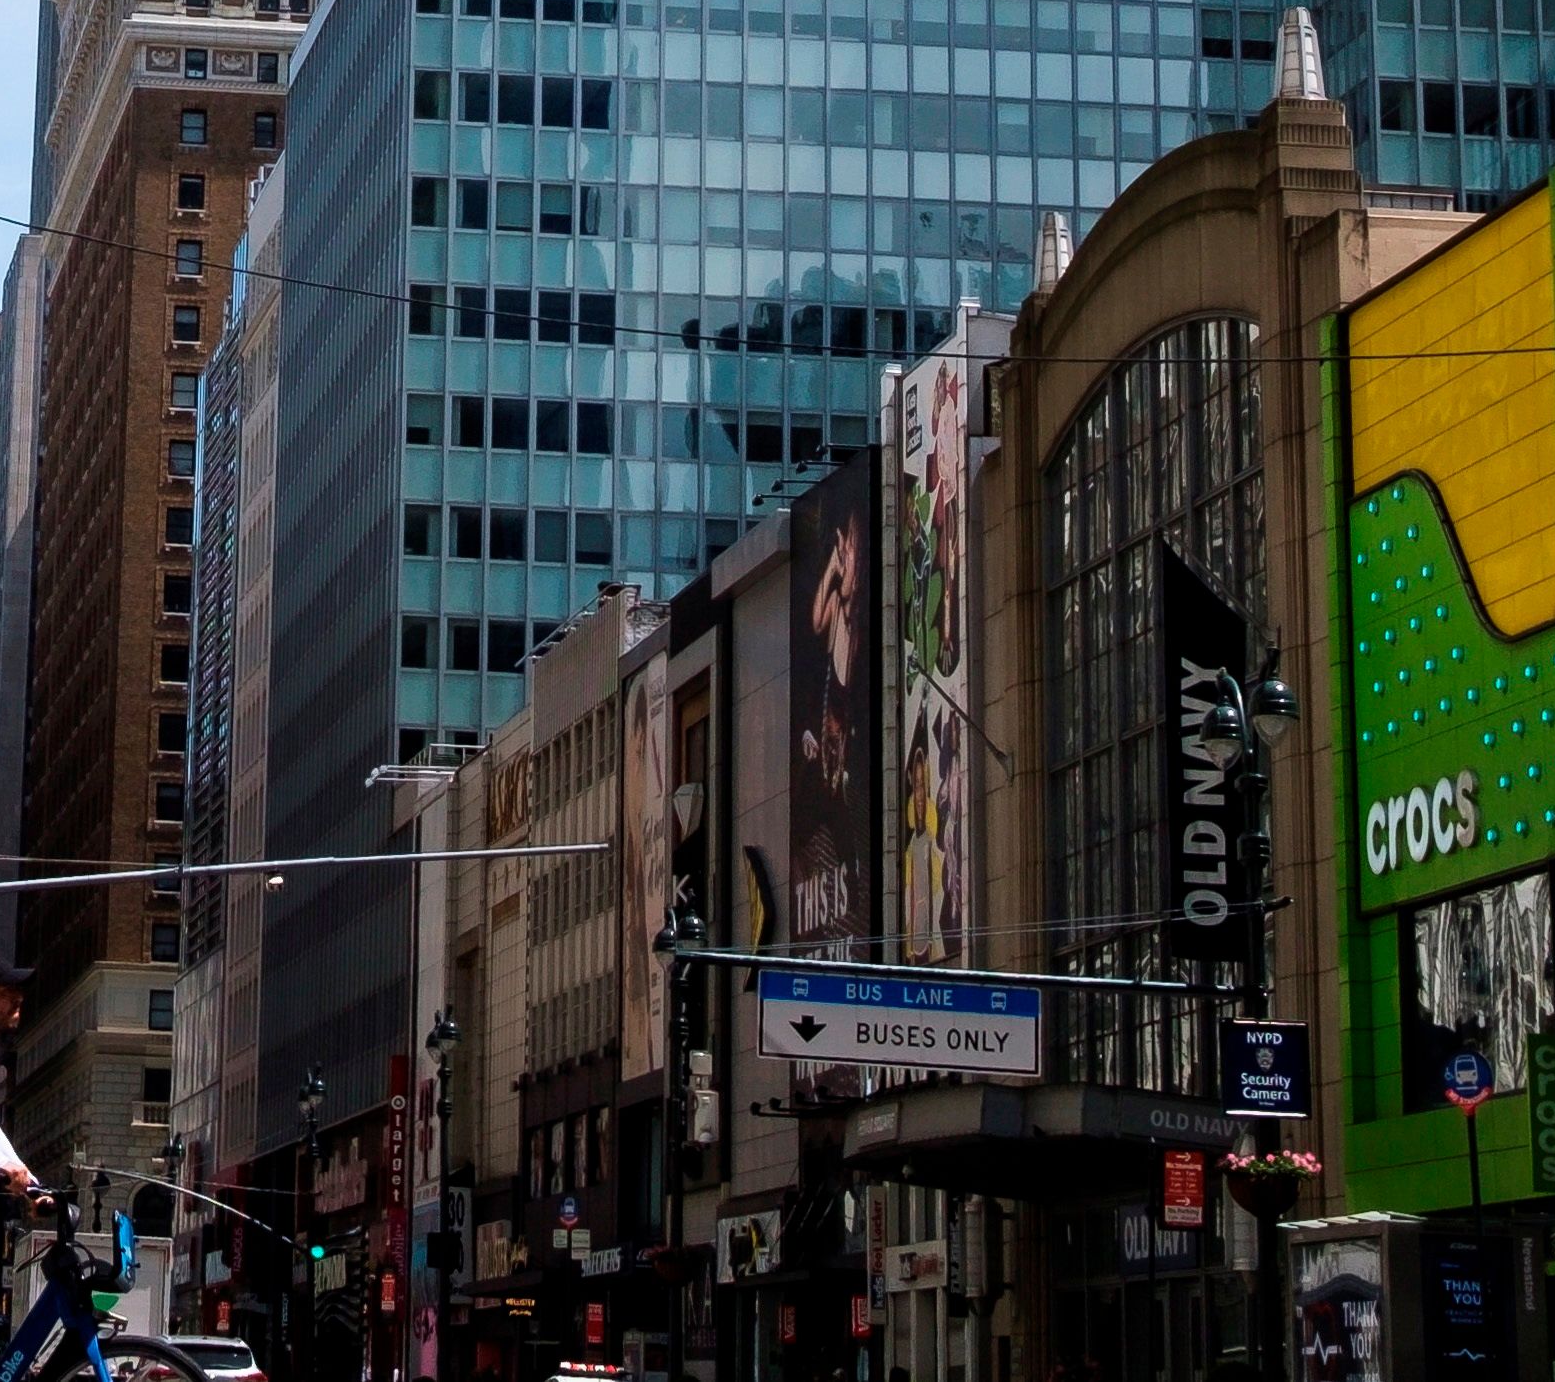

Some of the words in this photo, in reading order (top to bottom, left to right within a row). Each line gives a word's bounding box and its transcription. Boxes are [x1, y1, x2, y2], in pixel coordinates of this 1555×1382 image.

[1366, 768, 1479, 876] crocs
[1183, 820, 1228, 926] OLD
[795, 870, 828, 935] THIS
[834, 861, 848, 918] IS
[846, 984, 883, 1002] BUS
[903, 987, 953, 1007] LANE
[857, 1023, 936, 1047] BUSES
[947, 1029, 1009, 1053] ONLY
[1246, 1032, 1283, 1045] NYPD
[1241, 1072, 1291, 1089] Security
[1242, 1086, 1290, 1101] Camera
[1150, 1110, 1189, 1130] OLD
[1194, 1116, 1249, 1137] NAVY
[1124, 1215, 1149, 1258] OLD
[1521, 1237, 1537, 1312] Newsstand
[1453, 1293, 1482, 1306] YOU
[1342, 1300, 1379, 1327] THANK
[1349, 1332, 1372, 1360] YOU
